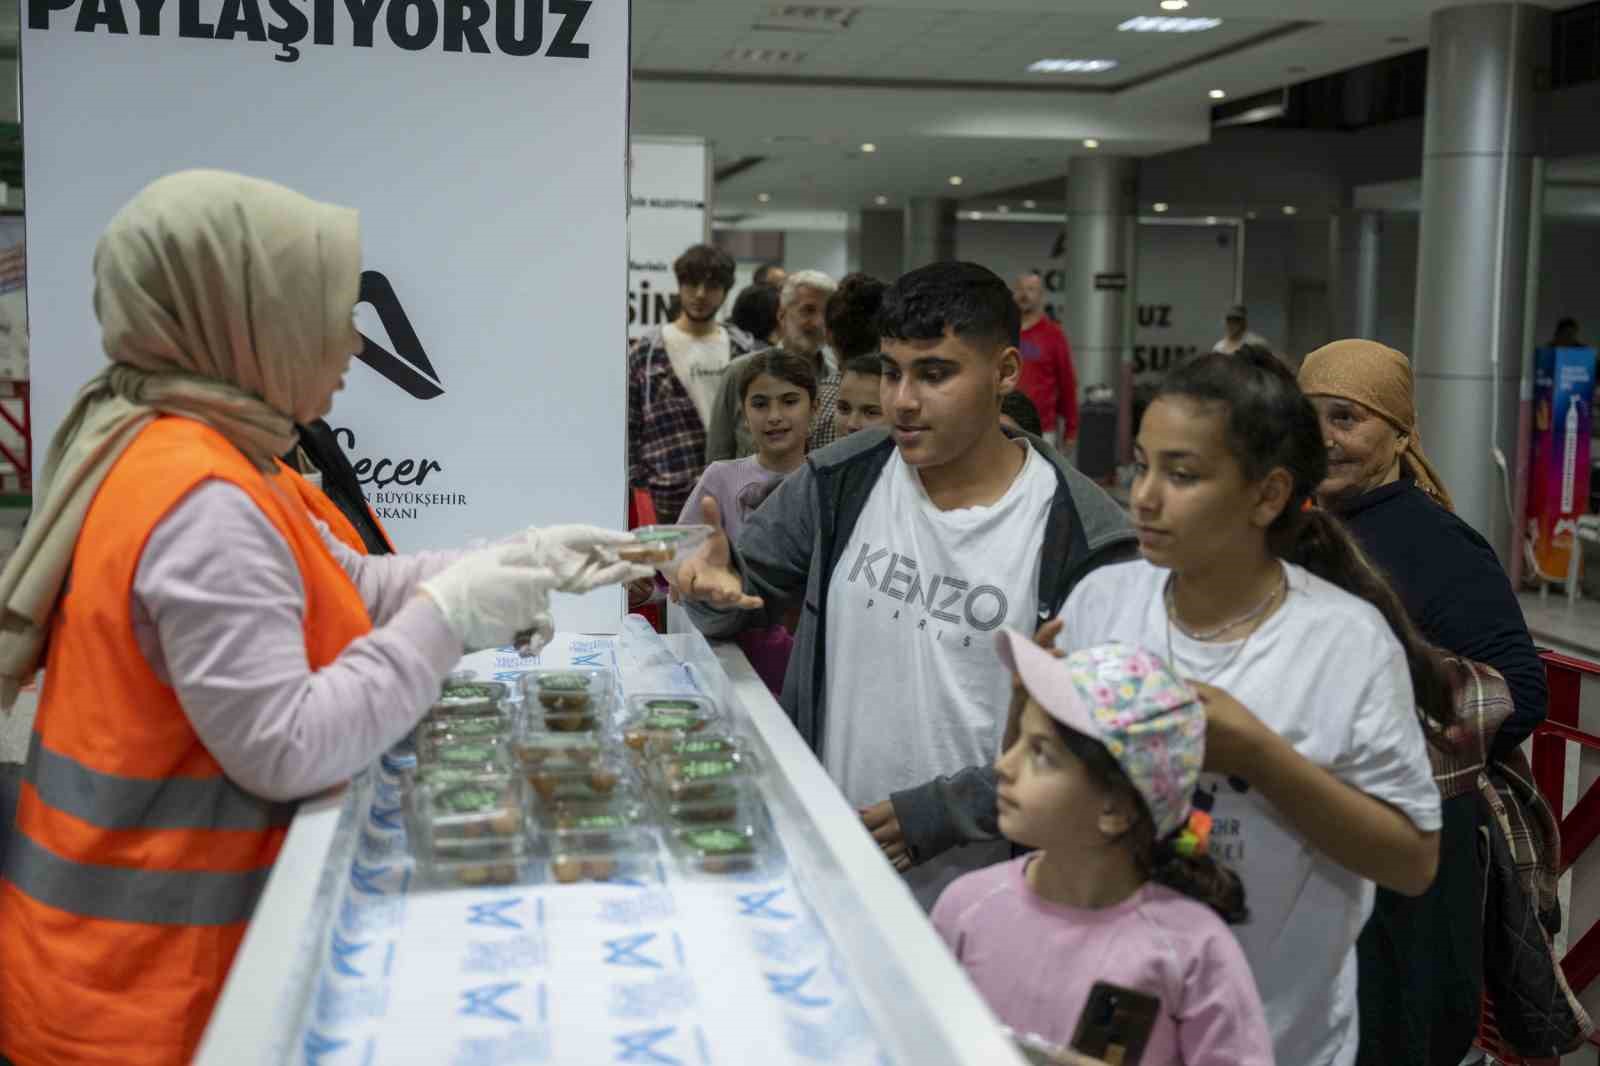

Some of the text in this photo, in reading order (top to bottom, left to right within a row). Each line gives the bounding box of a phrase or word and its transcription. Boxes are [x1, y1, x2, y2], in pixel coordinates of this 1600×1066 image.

[28, 0, 593, 62] PAYLAŞIYORUZ
[376, 490, 467, 507] BÜYÜKŞEHİR
[848, 542, 1009, 632] KENZO
[866, 598, 971, 648] PARIS
